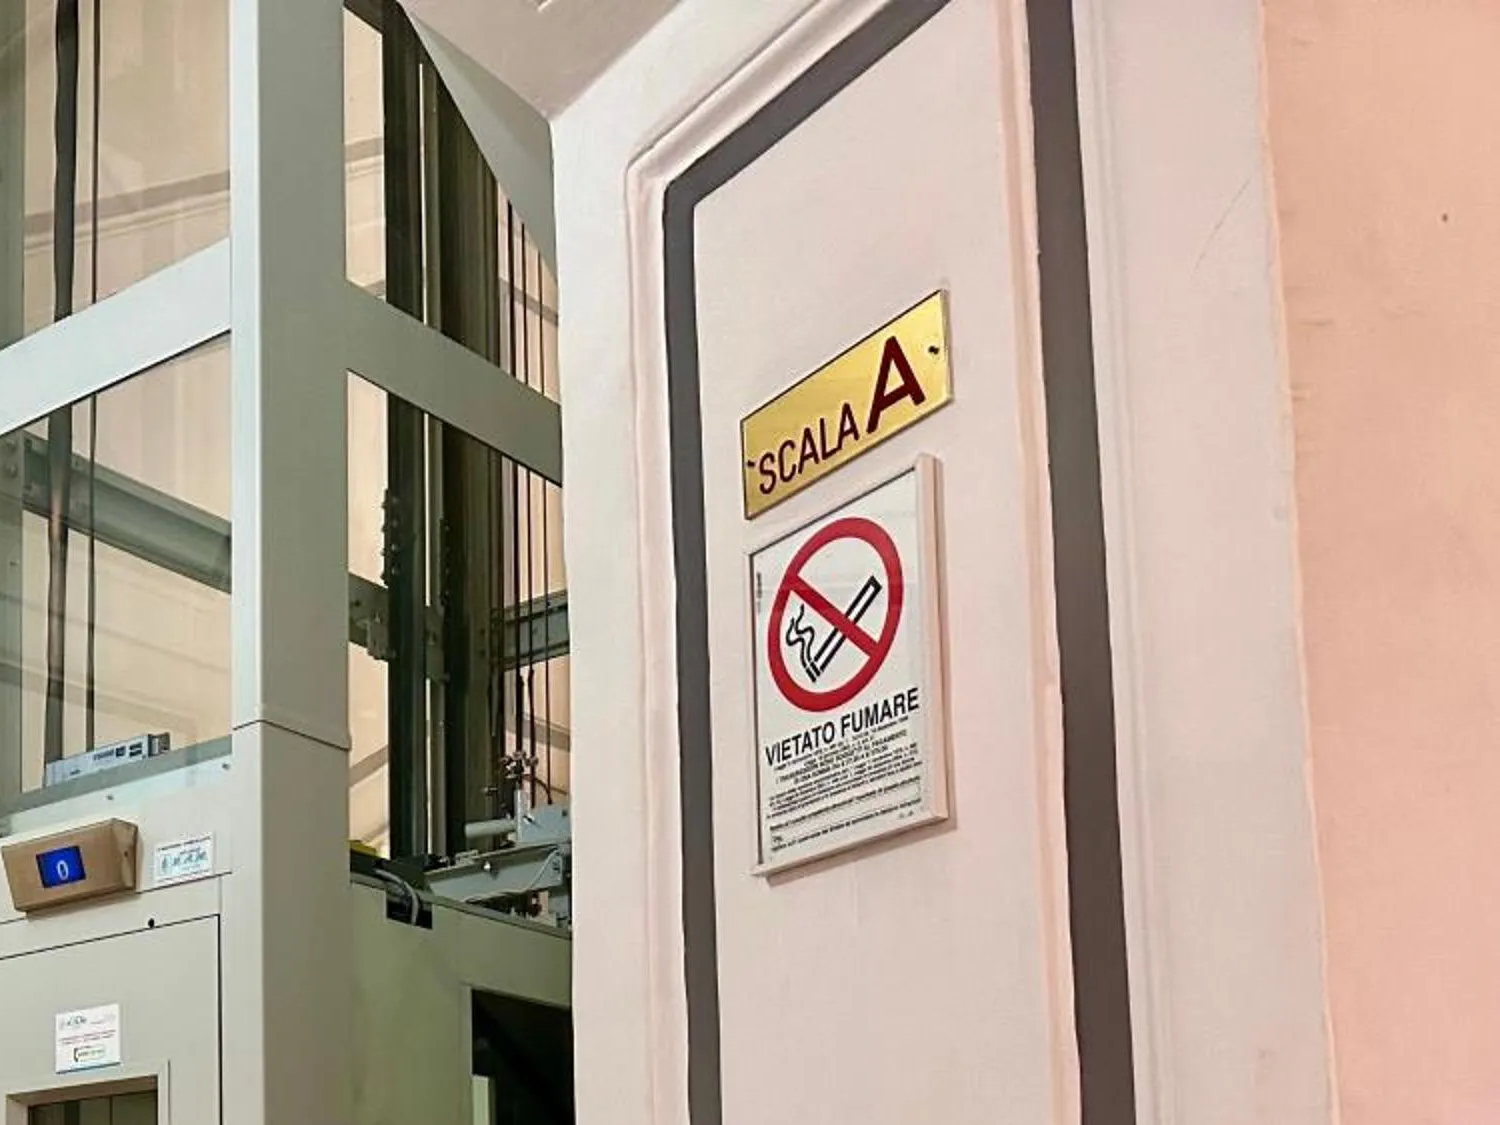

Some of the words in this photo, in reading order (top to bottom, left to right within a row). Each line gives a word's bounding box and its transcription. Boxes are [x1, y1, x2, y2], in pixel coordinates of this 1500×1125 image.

[758, 402, 860, 495] SCALA
[866, 335, 926, 434] A
[765, 721, 836, 767] VIETATO
[840, 687, 920, 739] FUMARE
[57, 859, 69, 881] 0
